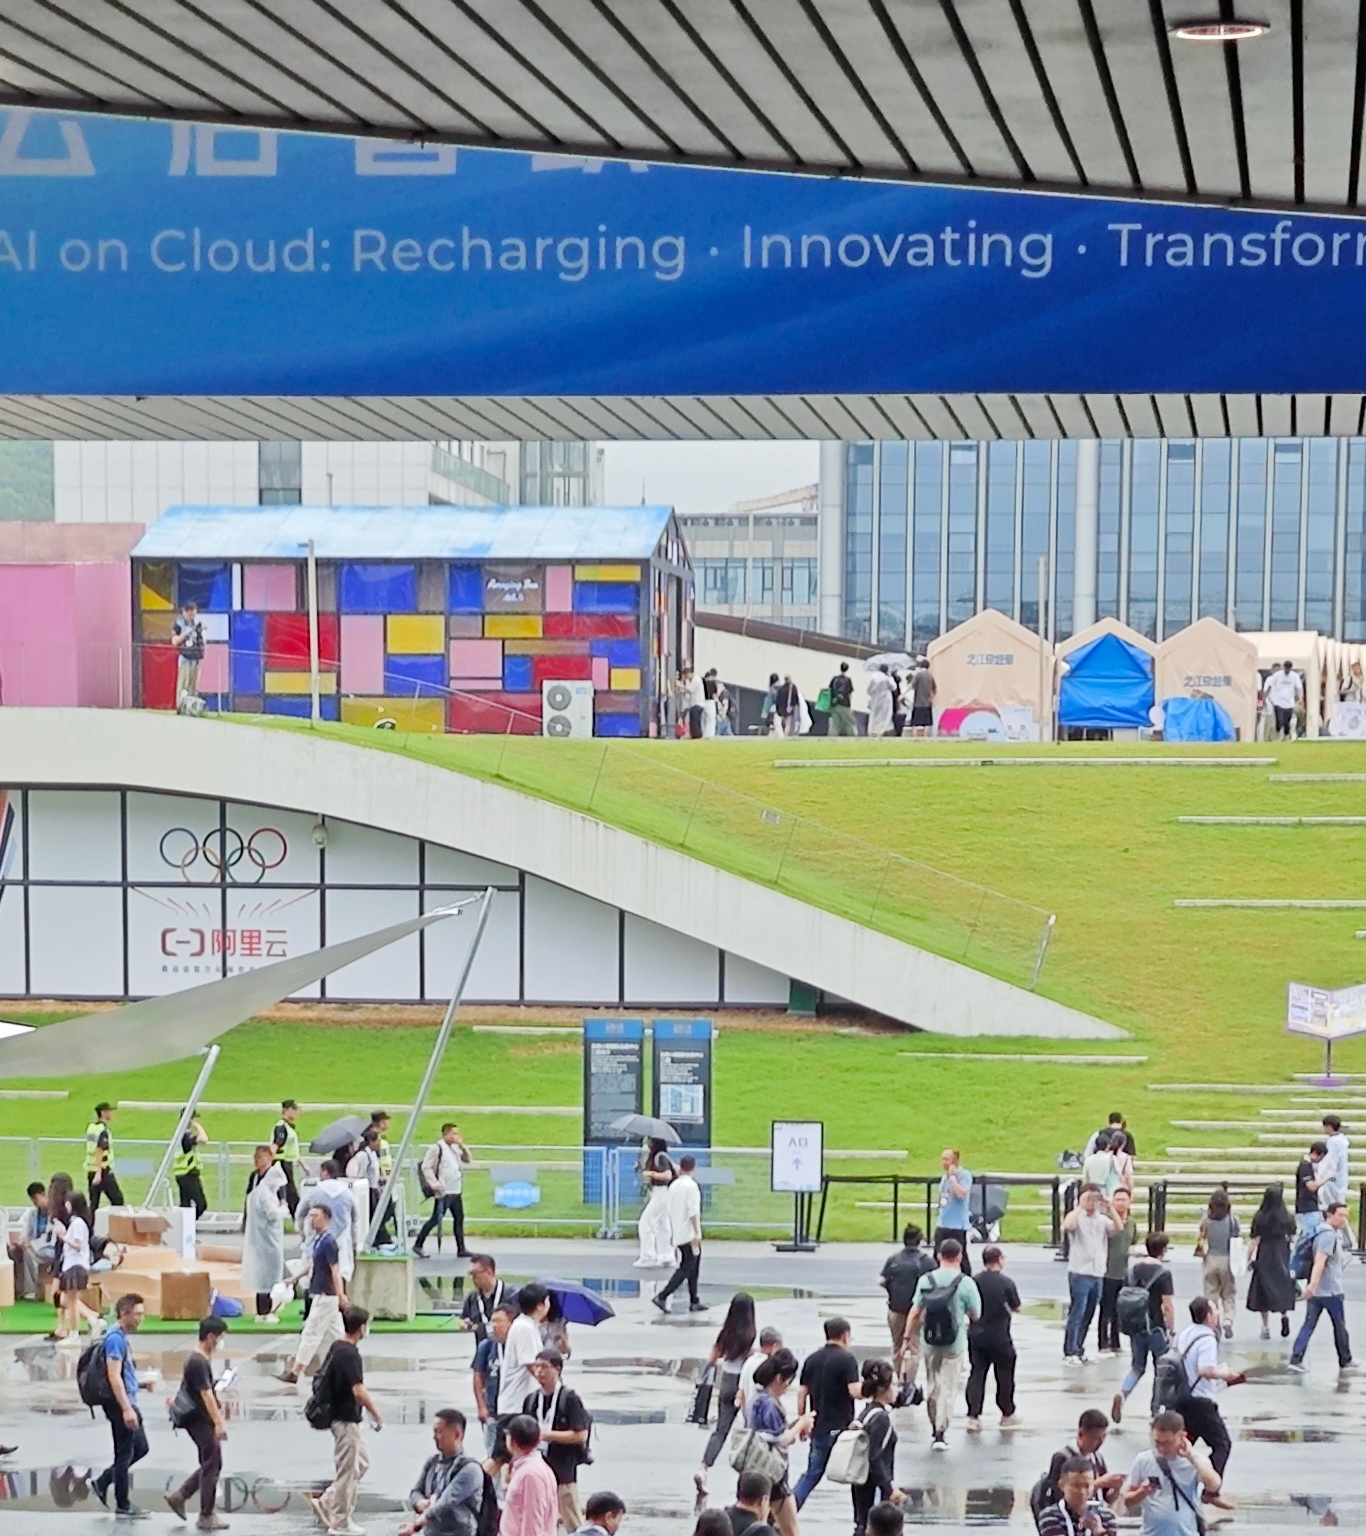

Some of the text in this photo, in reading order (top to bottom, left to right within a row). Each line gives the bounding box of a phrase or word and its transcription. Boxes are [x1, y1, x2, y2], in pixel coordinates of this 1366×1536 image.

[60, 240, 127, 272] on
[150, 228, 332, 273] Cloud:
[353, 224, 685, 282] Recharging
[742, 218, 1054, 279] Innovating
[211, 928, 288, 957] 阿里云
